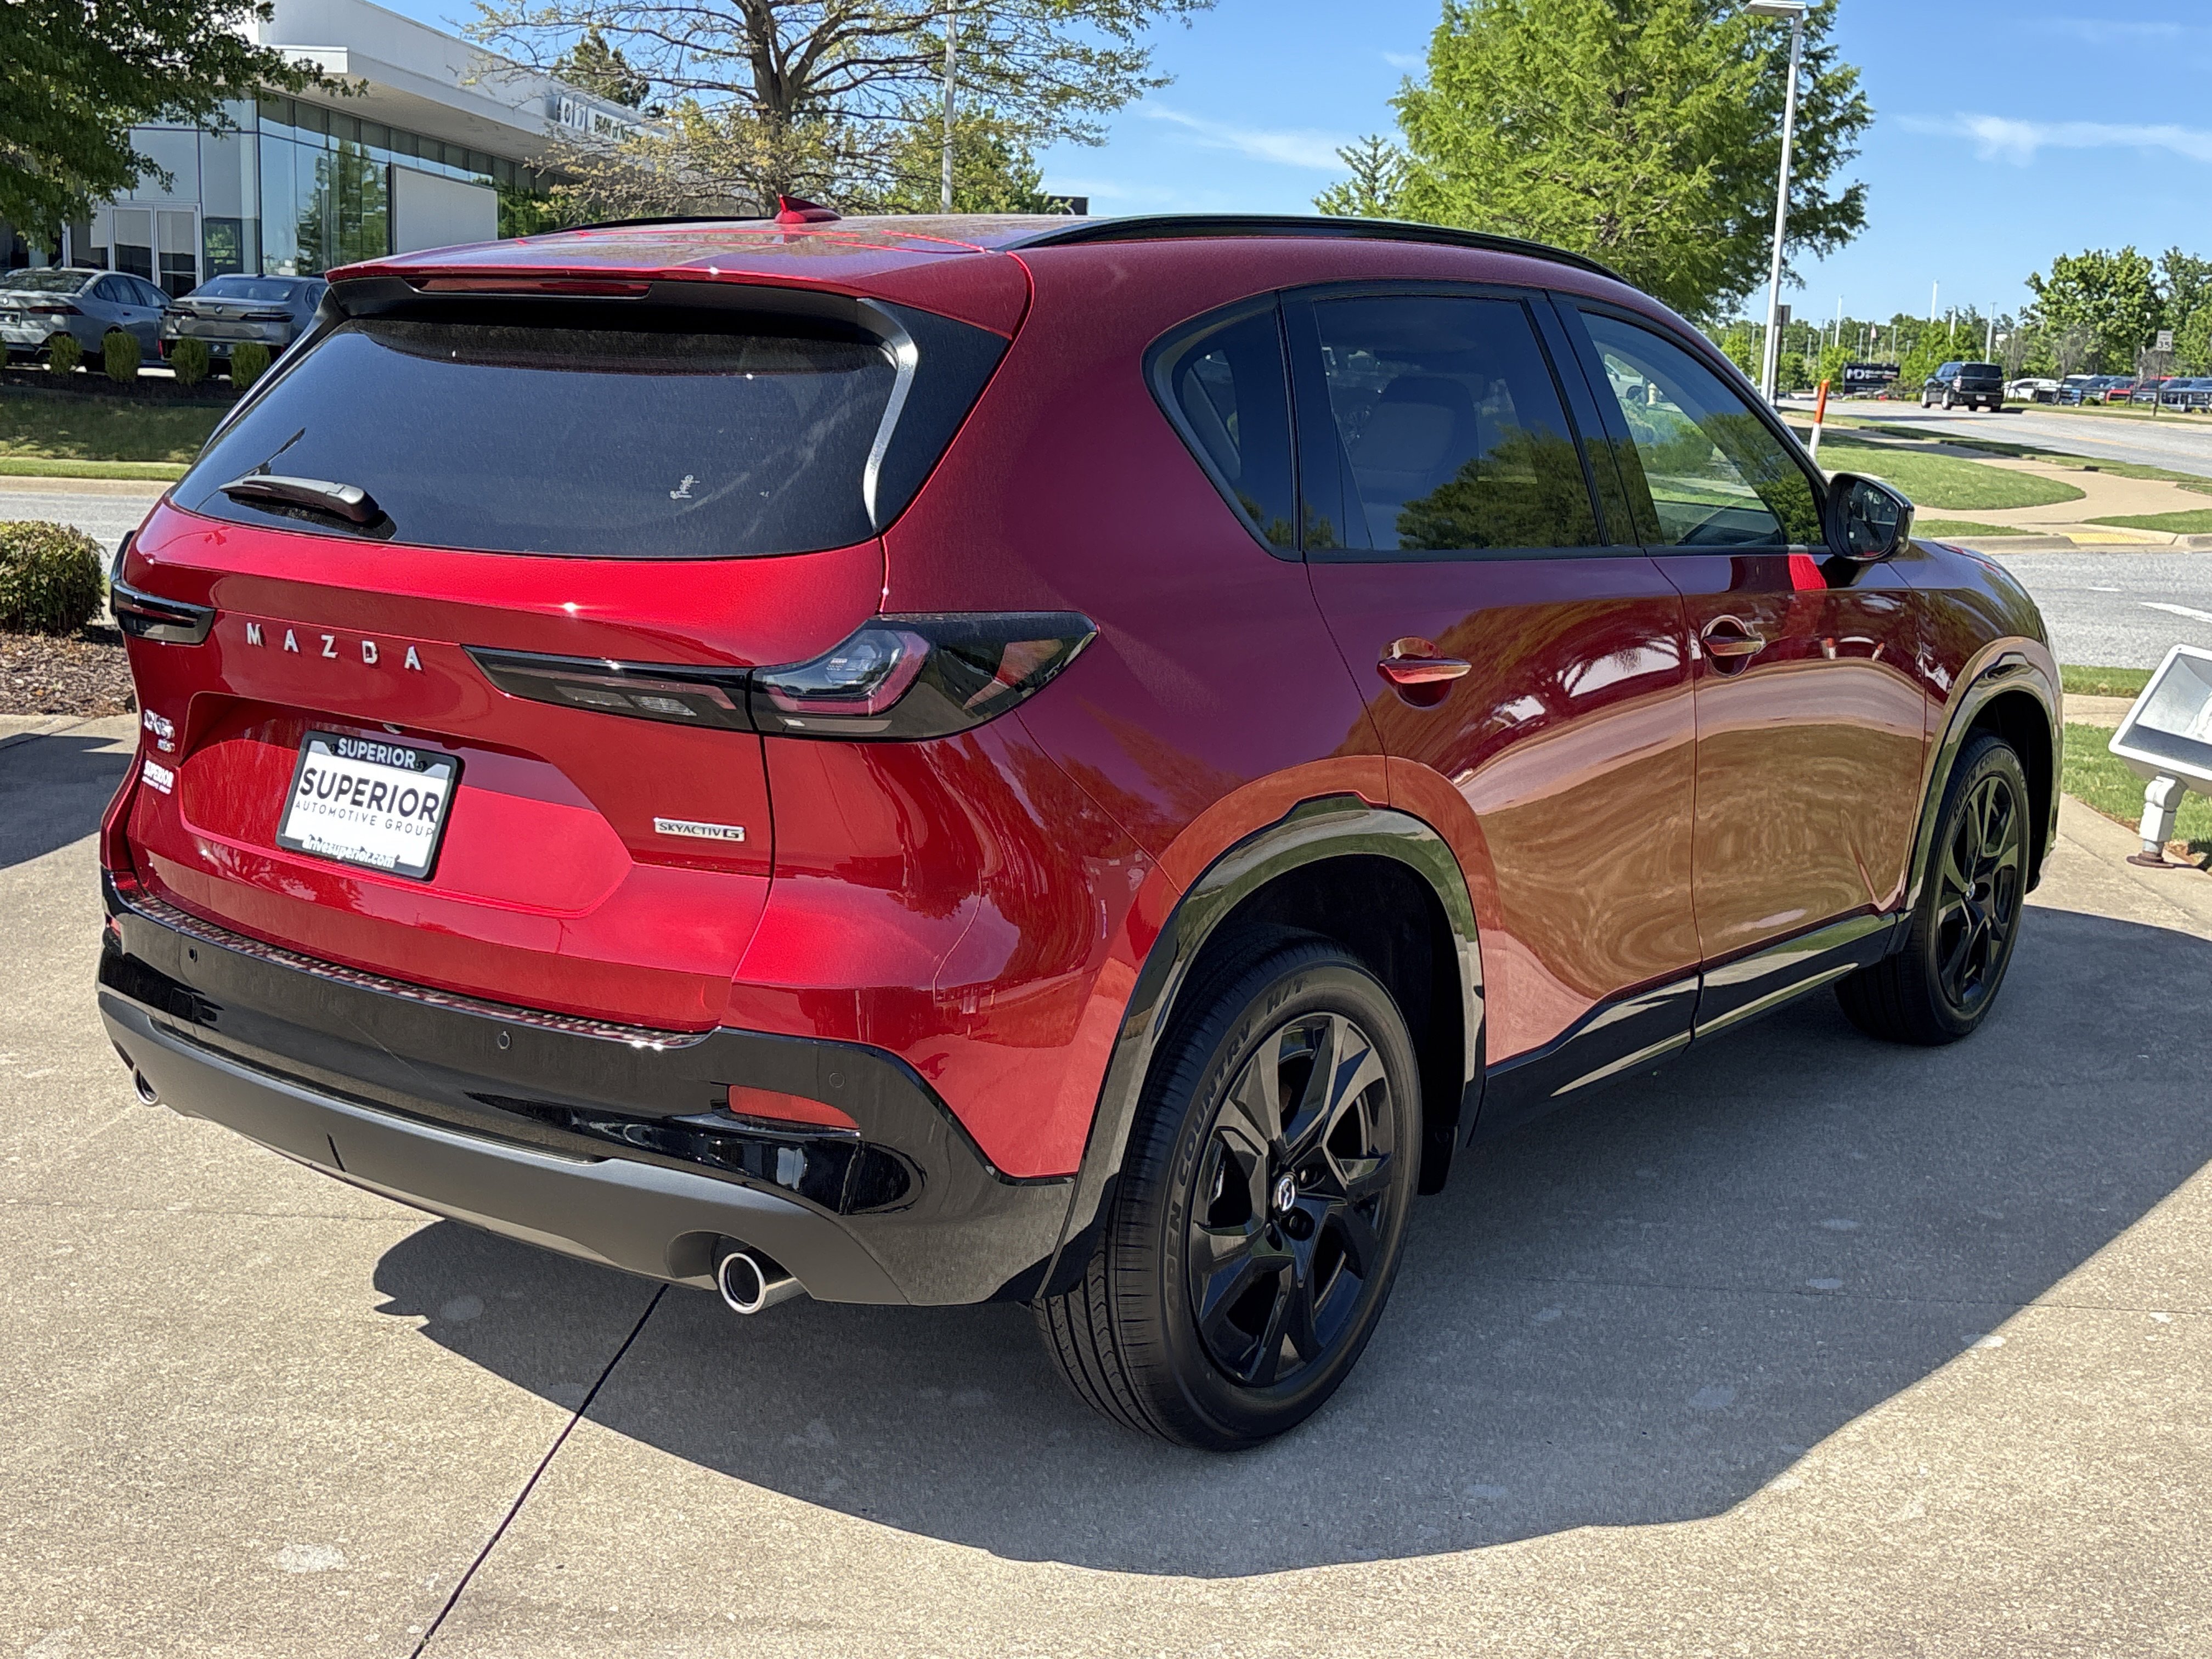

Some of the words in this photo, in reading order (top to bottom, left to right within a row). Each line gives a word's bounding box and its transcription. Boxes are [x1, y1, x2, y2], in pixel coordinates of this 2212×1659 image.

[247, 623, 422, 670] MAZDA
[337, 738, 416, 768] SUPERIOR
[295, 800, 377, 826] AUTOMOTIVE
[385, 819, 435, 837] GROUP
[300, 767, 439, 823] SUPERIOR
[1166, 1198, 1182, 1310] OPEN
[1179, 1018, 1251, 1186] COUNTRY
